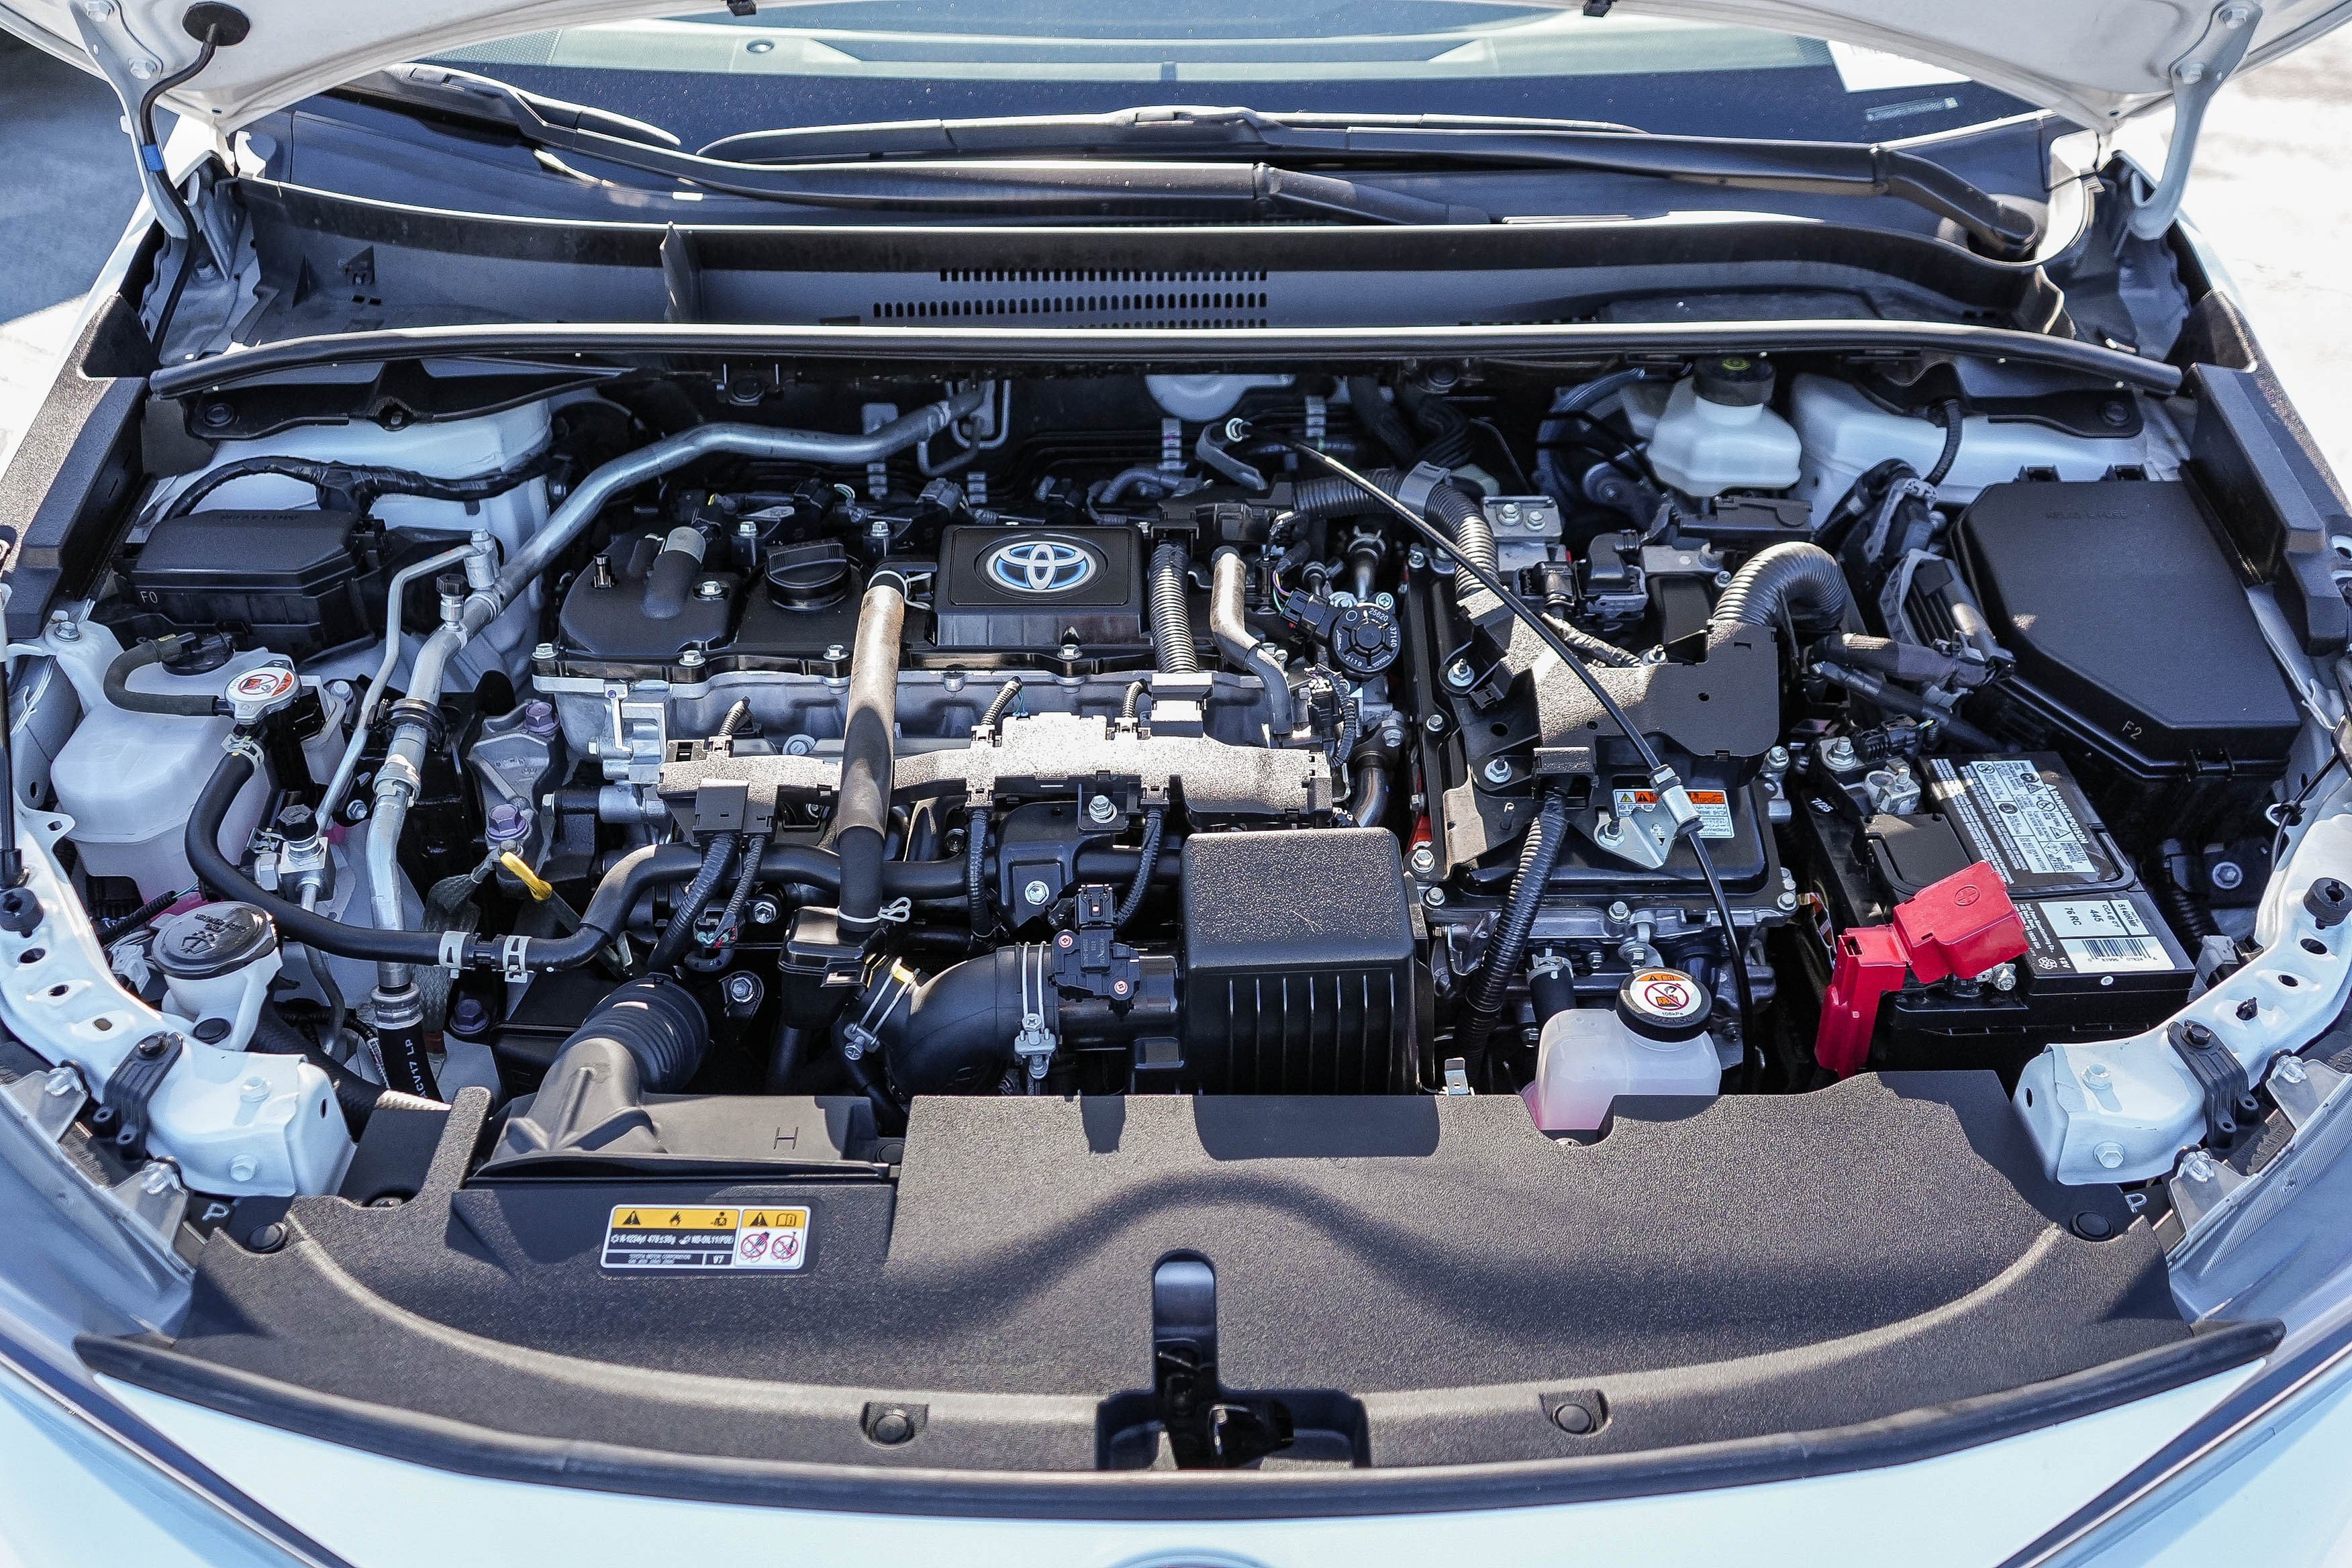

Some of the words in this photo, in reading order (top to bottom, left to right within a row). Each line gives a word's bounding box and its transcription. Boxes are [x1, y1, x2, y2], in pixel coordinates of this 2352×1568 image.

[1368, 607, 1389, 622] 25620
[1389, 626, 1398, 648] 37140
[2122, 720, 2143, 740] F2
[2063, 907, 2075, 915] 76
[2069, 915, 2082, 926] RC
[2090, 909, 2104, 922] 445
[2102, 904, 2112, 914] CCA
[2117, 903, 2139, 928] 5140RMF
[2057, 957, 2071, 969] 12V
[773, 1127, 799, 1150] H
